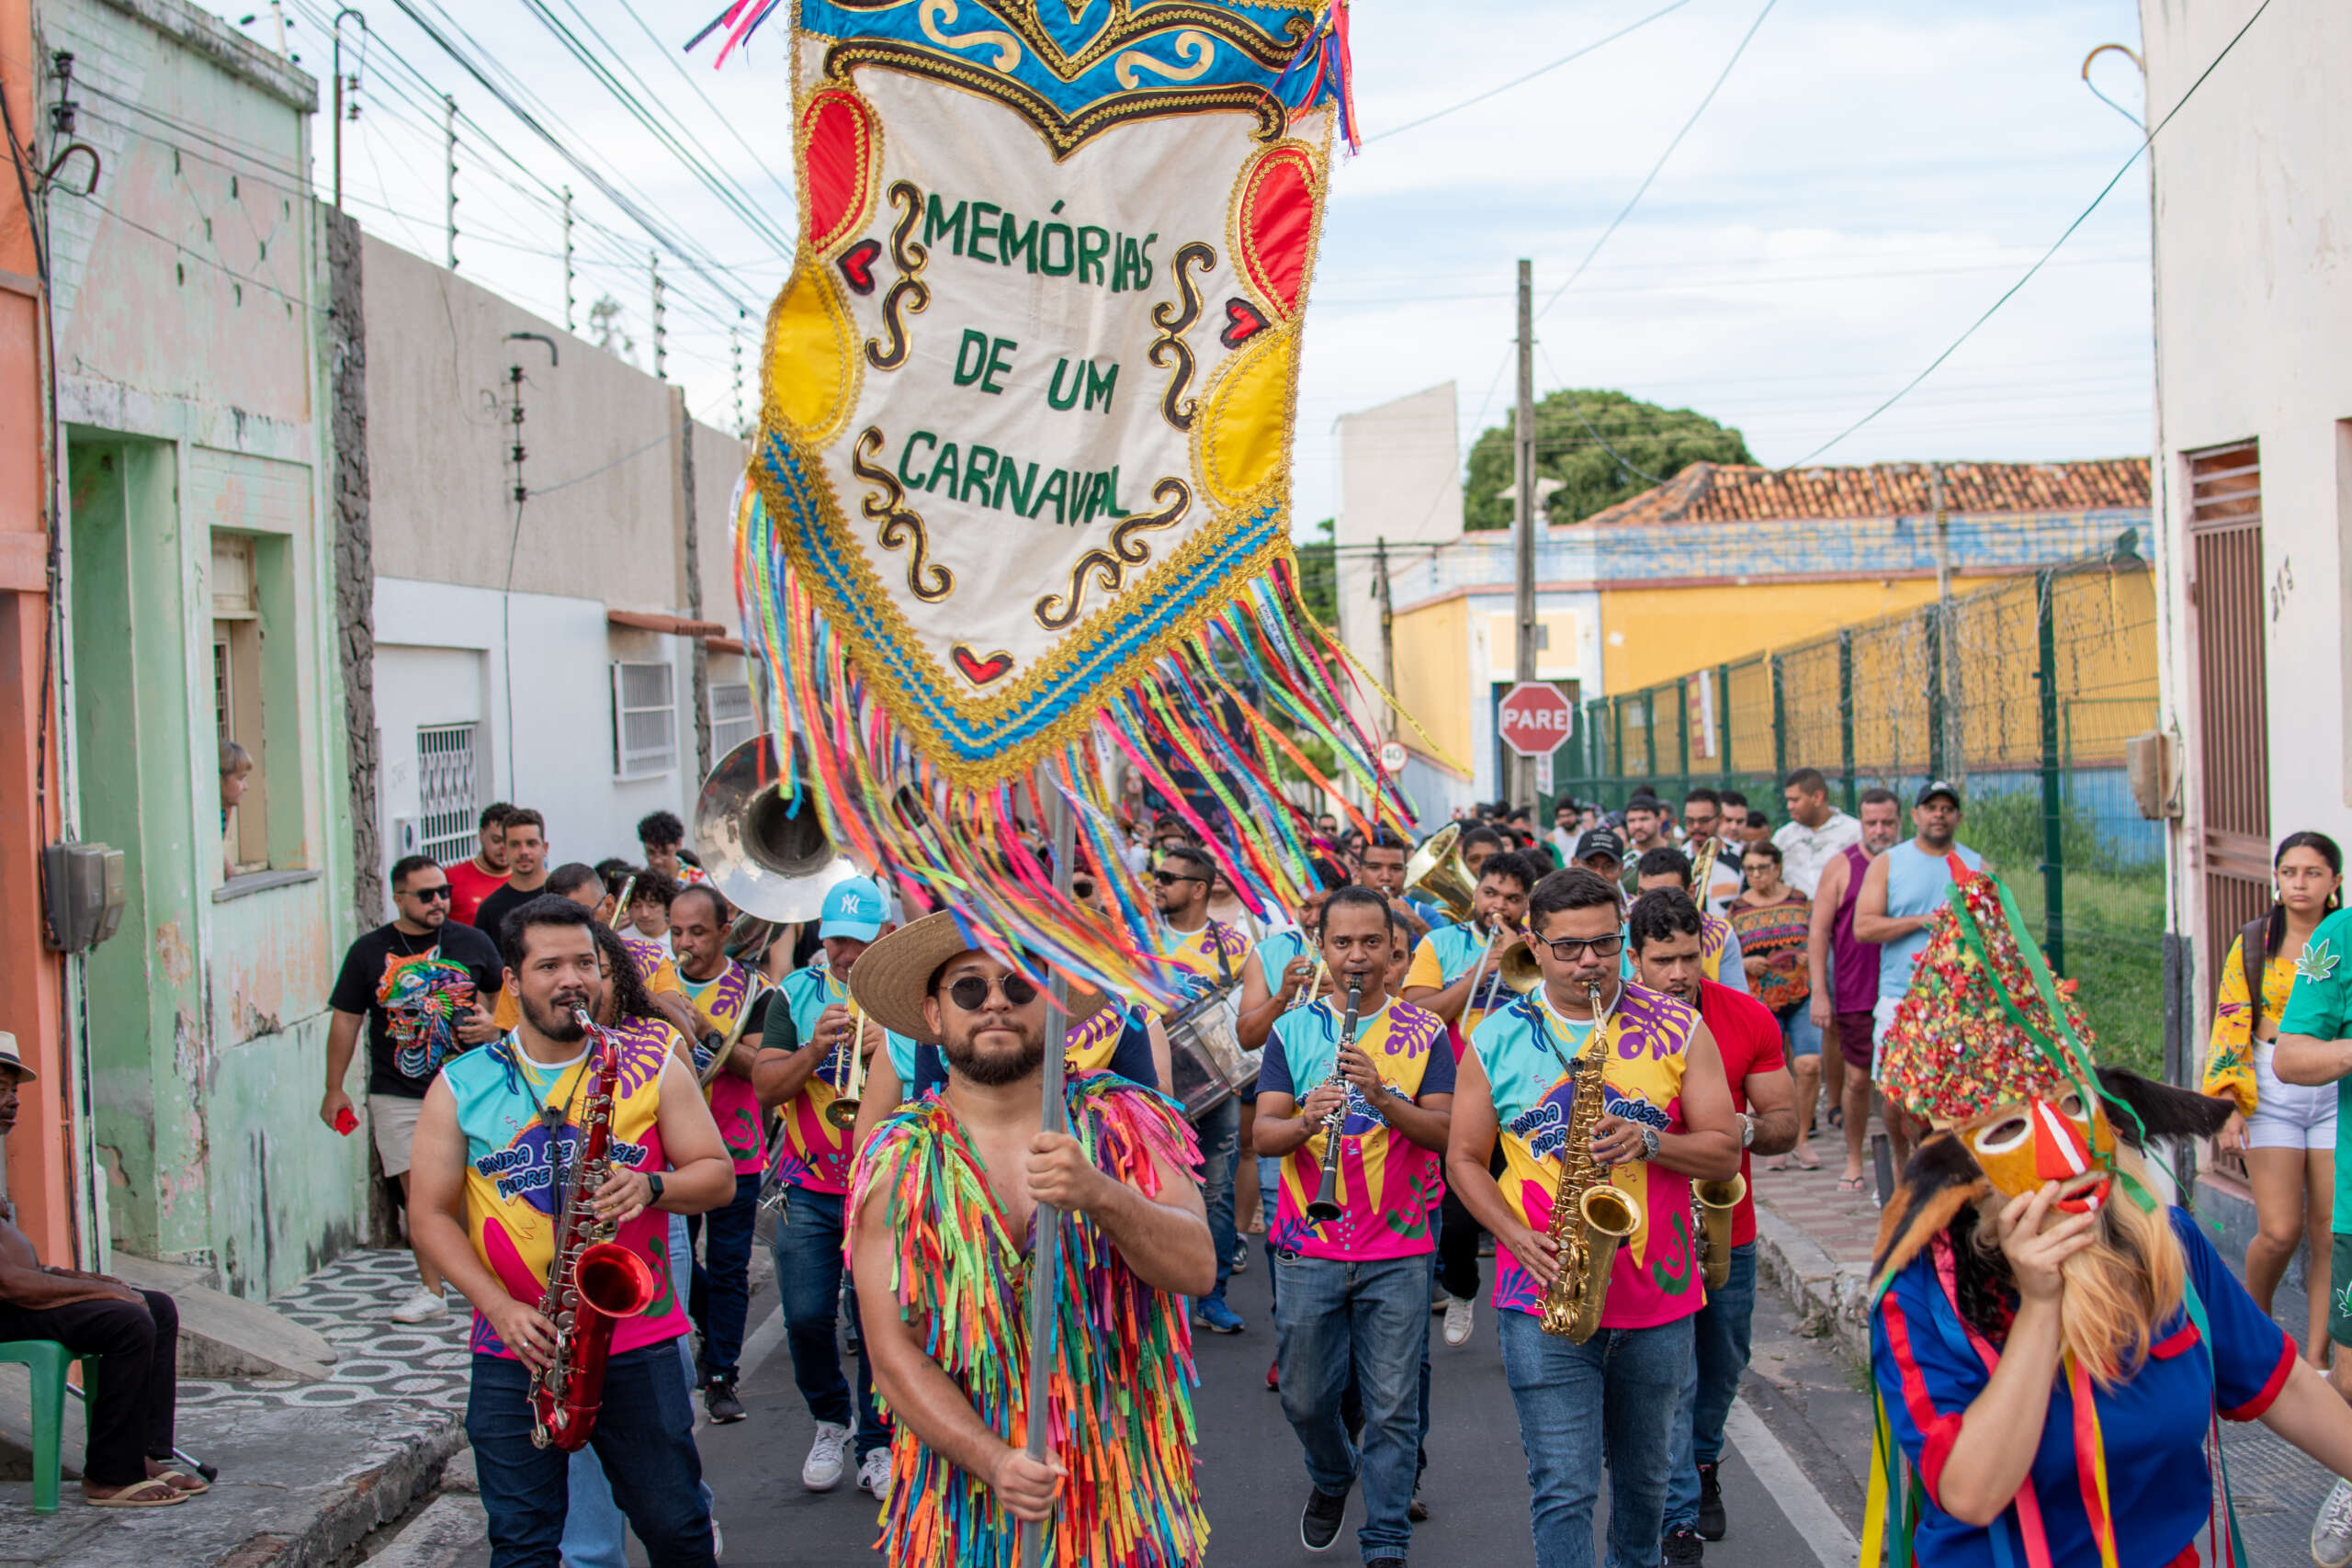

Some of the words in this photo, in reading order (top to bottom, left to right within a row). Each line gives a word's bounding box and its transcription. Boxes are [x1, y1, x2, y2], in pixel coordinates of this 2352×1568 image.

[923, 194, 1159, 293] MEMÓRIAS
[954, 328, 1017, 395] DE
[1047, 357, 1120, 414] UM
[898, 430, 1131, 527] CARNAVAL
[1504, 708, 1567, 731] PARE
[1383, 748, 1404, 761] 40
[1531, 1126, 1567, 1158] PADR
[476, 1145, 532, 1177] BANDA
[496, 1168, 552, 1200] PADRE
